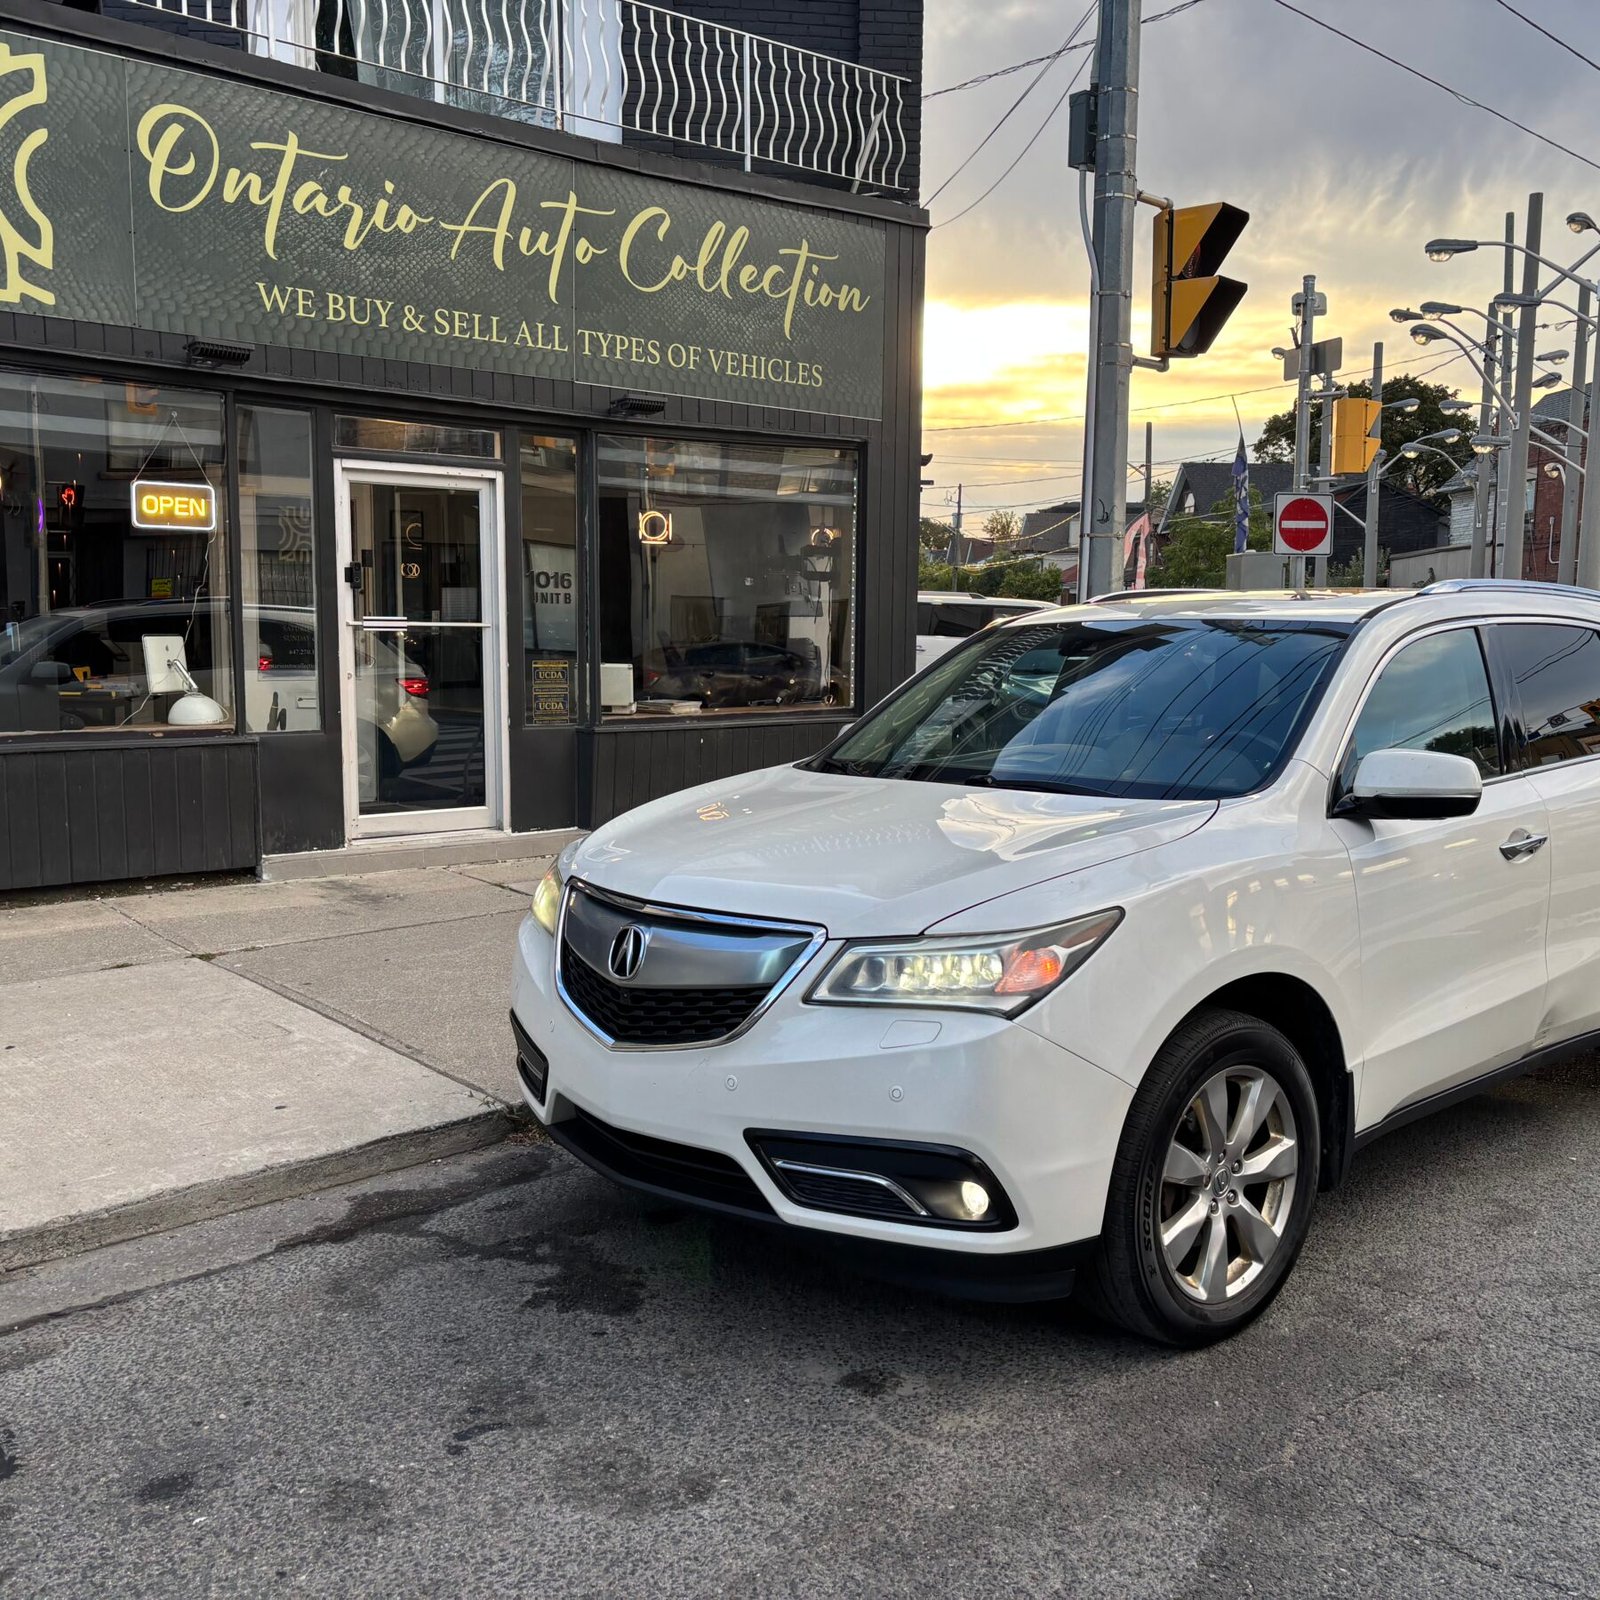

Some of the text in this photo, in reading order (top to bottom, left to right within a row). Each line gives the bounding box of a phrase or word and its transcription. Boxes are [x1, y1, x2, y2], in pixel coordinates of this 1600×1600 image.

[136, 103, 870, 341] Ontario Auto Collection
[255, 281, 824, 388] WE BUY & SELL ALL TYPES OF VEHICLES
[141, 494, 206, 517] OPEN
[525, 570, 572, 589] 1016
[564, 592, 572, 604] B
[538, 671, 563, 679] UCDA
[538, 702, 564, 710] UCDA
